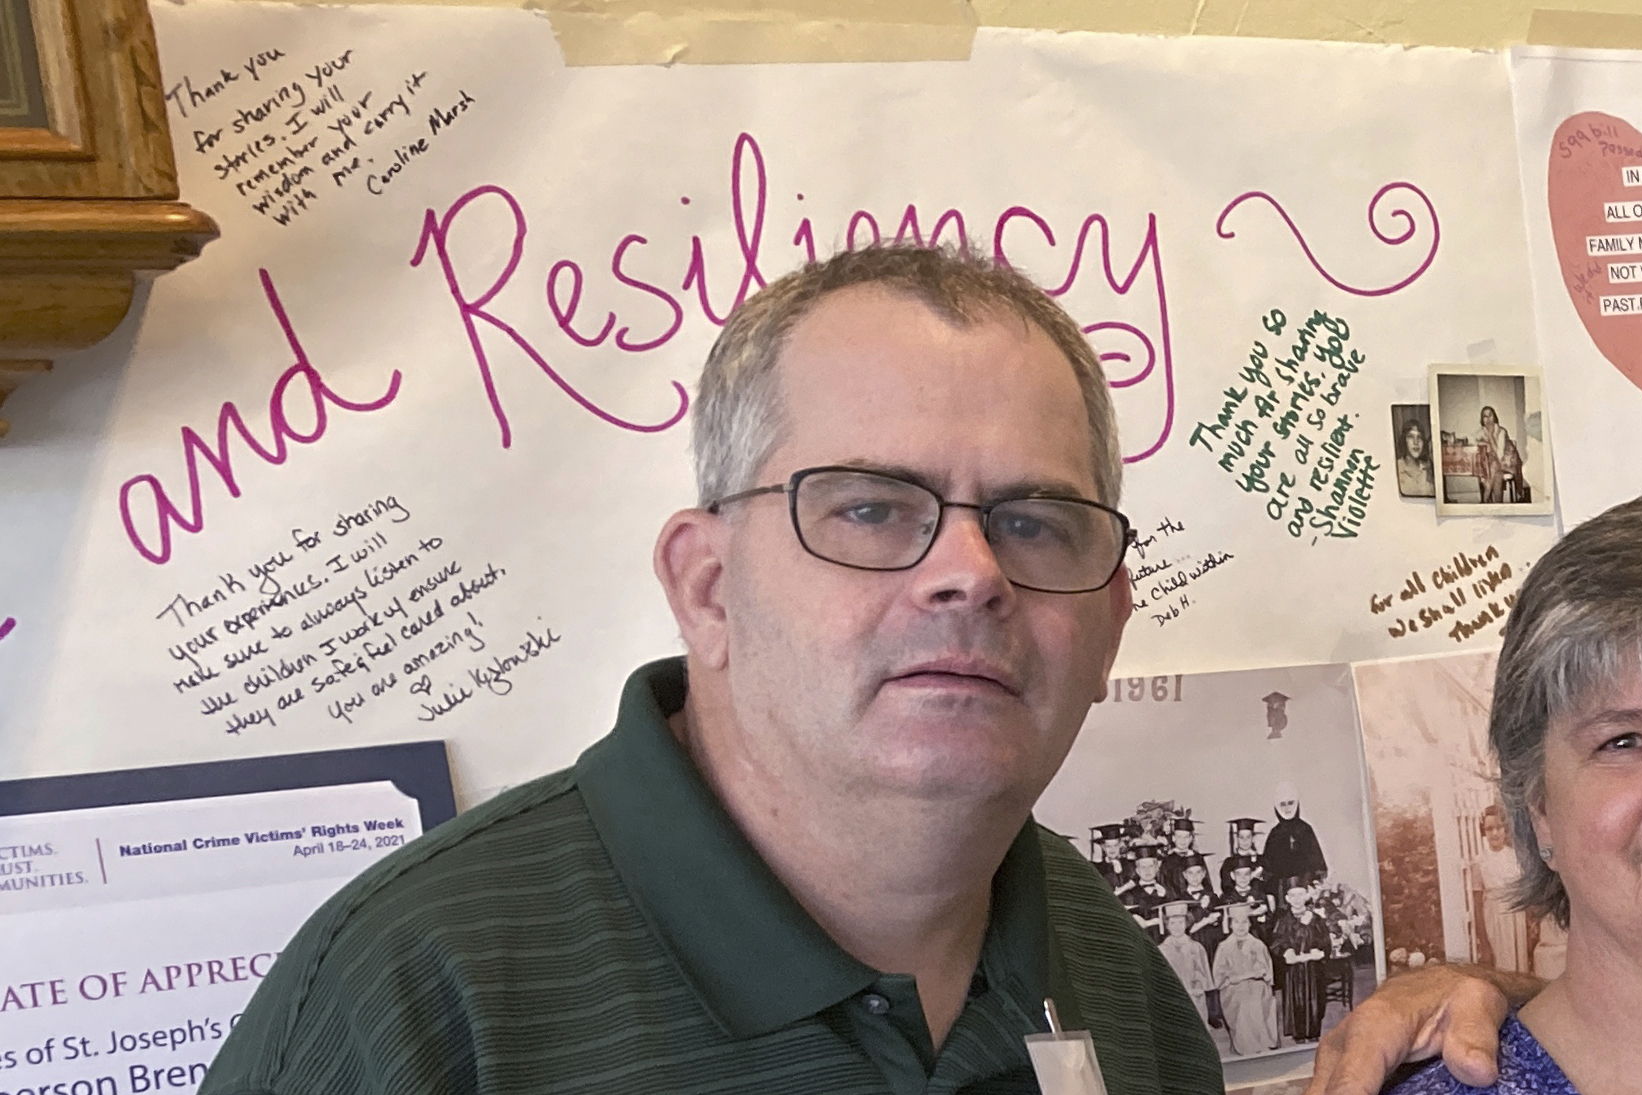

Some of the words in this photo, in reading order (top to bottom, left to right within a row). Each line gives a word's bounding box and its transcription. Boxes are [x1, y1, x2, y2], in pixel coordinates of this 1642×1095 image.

[166, 69, 239, 117] Thank
[245, 49, 285, 80] you
[194, 129, 223, 154] for
[232, 81, 306, 134] sharing
[305, 49, 353, 87] your
[286, 112, 307, 134] I
[311, 84, 345, 116] will
[328, 91, 373, 134] your
[252, 165, 313, 215] wisdom
[321, 132, 357, 165] and
[364, 94, 410, 135] carry
[406, 71, 428, 95] it
[1627, 169, 1640, 183] IN
[274, 189, 317, 226] with
[1607, 205, 1630, 219] ALL
[1589, 236, 1634, 253] FAMILY
[1610, 264, 1636, 279] NOT
[1189, 387, 1247, 452] Thank
[1239, 341, 1272, 387] you
[1263, 309, 1286, 335] so
[119, 268, 401, 564] and
[1267, 472, 1296, 520] are
[1295, 434, 1314, 465] all
[1307, 409, 1326, 430] so
[1321, 349, 1365, 406] brave
[1218, 420, 1258, 472] much
[1235, 441, 1276, 492] your
[1288, 497, 1314, 537] and
[1331, 456, 1380, 537] Violette
[1157, 517, 1185, 536] the
[156, 572, 246, 628] Thank
[249, 551, 293, 596] you
[291, 529, 320, 552] for
[332, 496, 411, 538] sharing
[1189, 551, 1234, 580] within
[169, 625, 219, 666] your
[326, 554, 349, 573] I
[351, 532, 388, 564] will
[223, 640, 269, 669] sure
[271, 624, 292, 640] to
[300, 586, 368, 632] always
[364, 553, 419, 588] listen
[418, 537, 443, 552] to
[1401, 571, 1426, 601] all
[342, 611, 383, 645] work
[1151, 605, 1180, 627] Deb
[225, 706, 276, 736] they
[400, 600, 445, 639] cared
[1114, 673, 1183, 702] 1961
[119, 839, 187, 857] National
[192, 835, 240, 849] Crime
[311, 822, 360, 838] Rights
[364, 817, 404, 831] Week
[293, 843, 325, 857] April
[375, 835, 406, 848] 2021
[79, 972, 128, 1000] OF
[139, 952, 283, 994] APPREC
[26, 1038, 55, 1065] of
[63, 1037, 98, 1059] St.
[107, 1018, 221, 1054] Joseph's
